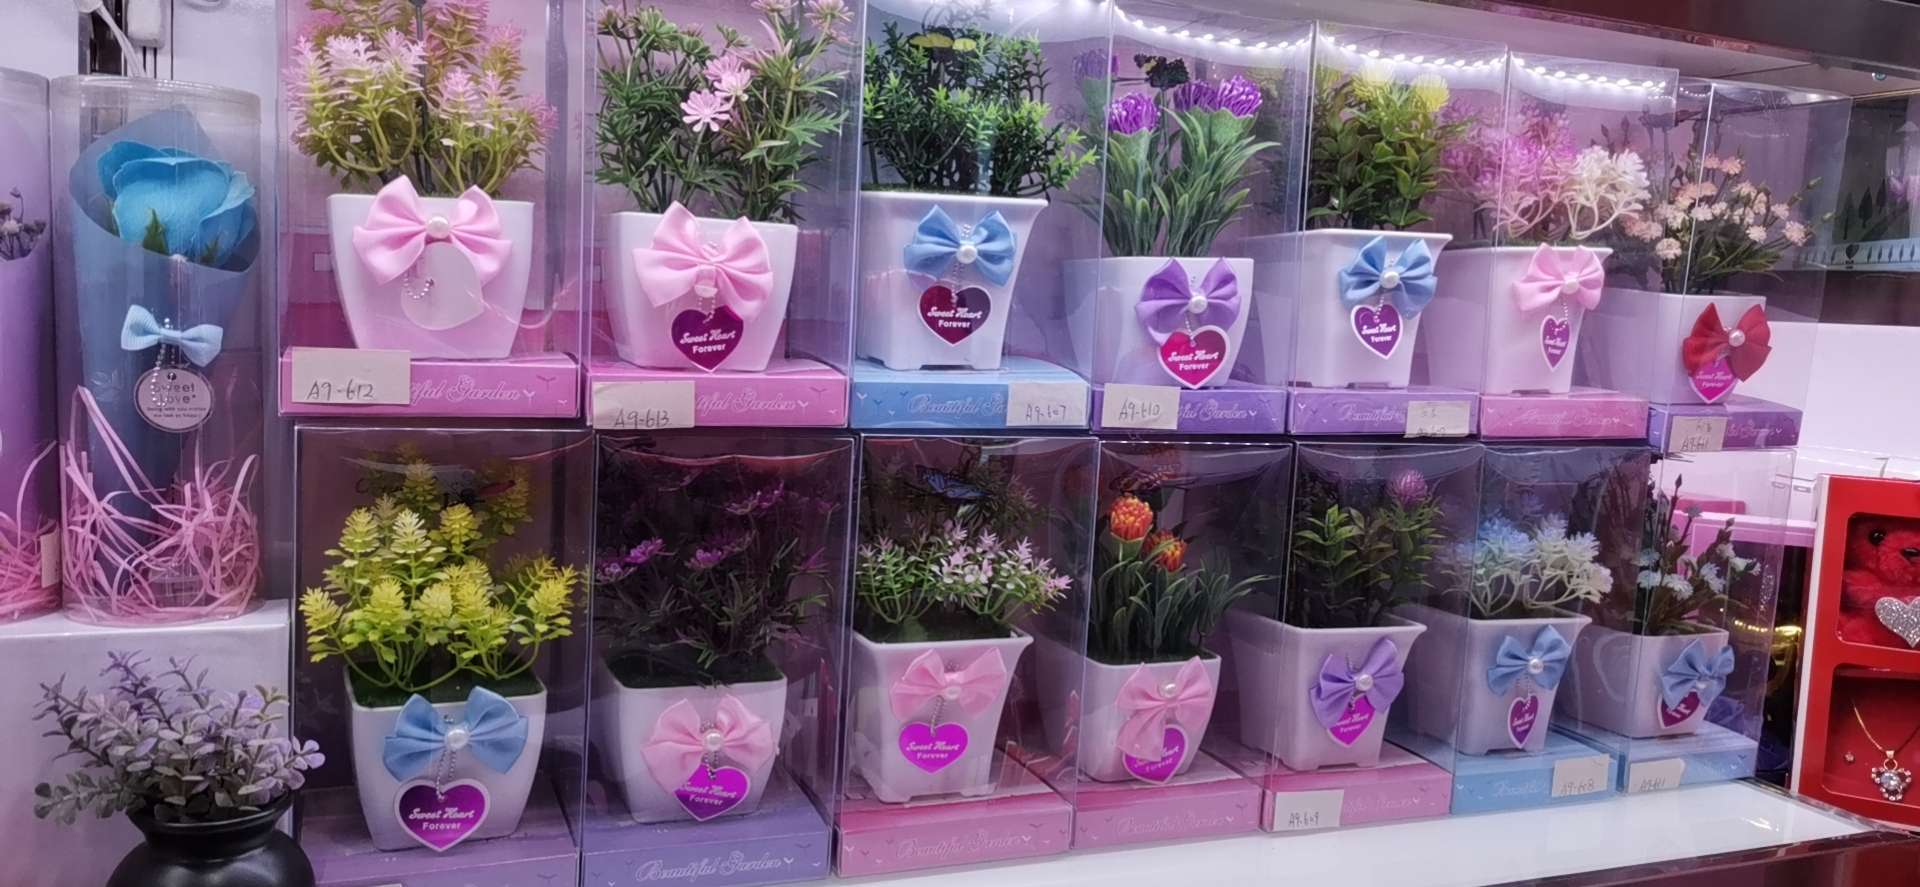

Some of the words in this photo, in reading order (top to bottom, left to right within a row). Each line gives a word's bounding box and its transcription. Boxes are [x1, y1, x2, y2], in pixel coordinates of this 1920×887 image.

[927, 306, 955, 318] Sweet
[955, 307, 983, 320] Heart
[938, 320, 971, 329] Forever
[679, 332, 708, 345] Sweet
[708, 329, 736, 342] Heart
[692, 343, 726, 354] Forever
[1168, 351, 1194, 362] Sweet
[1193, 350, 1219, 361] Heart
[1179, 362, 1209, 371] Forever
[307, 379, 374, 401] A9-612
[447, 374, 520, 402] Garden
[733, 387, 796, 412] Garden
[614, 408, 671, 428] A9-613
[906, 741, 933, 751] Sweet
[932, 741, 960, 751] Heart
[409, 808, 442, 819] Sweet
[443, 807, 475, 819] Heart
[422, 822, 461, 831] Forever
[635, 857, 718, 882] Beautiful
[719, 850, 782, 876] Garden
